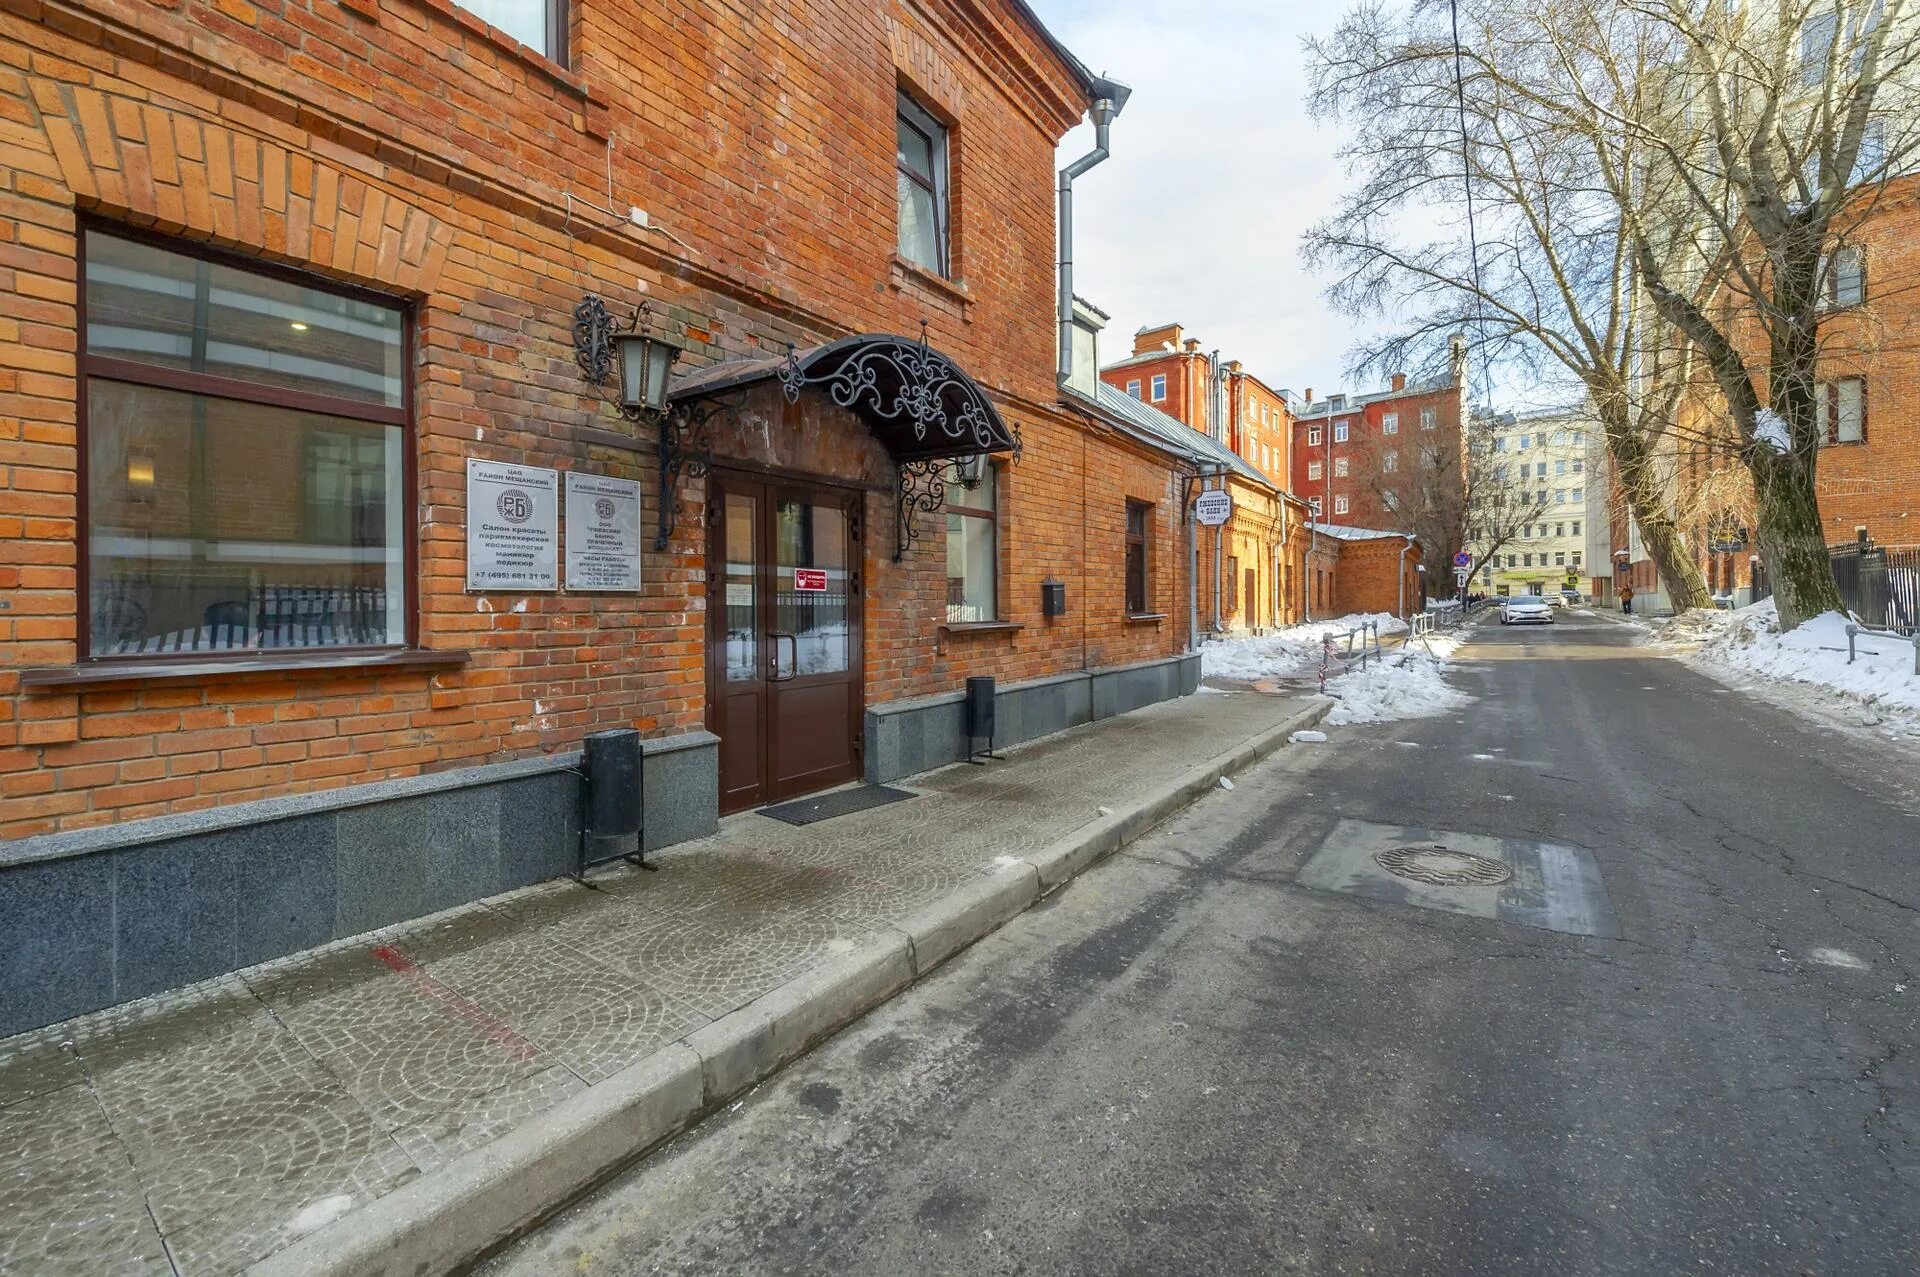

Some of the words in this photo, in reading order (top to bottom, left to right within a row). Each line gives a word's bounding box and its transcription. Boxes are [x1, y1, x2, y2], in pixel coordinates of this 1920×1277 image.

[478, 471, 504, 480] РАЙОН
[505, 475, 549, 486] МЕЩАНСКИЙ
[512, 527, 546, 535] красоты
[479, 533, 549, 542] парикмахерская
[485, 543, 544, 551] косметология
[495, 551, 535, 559] маникюр
[488, 572, 510, 580] (495)
